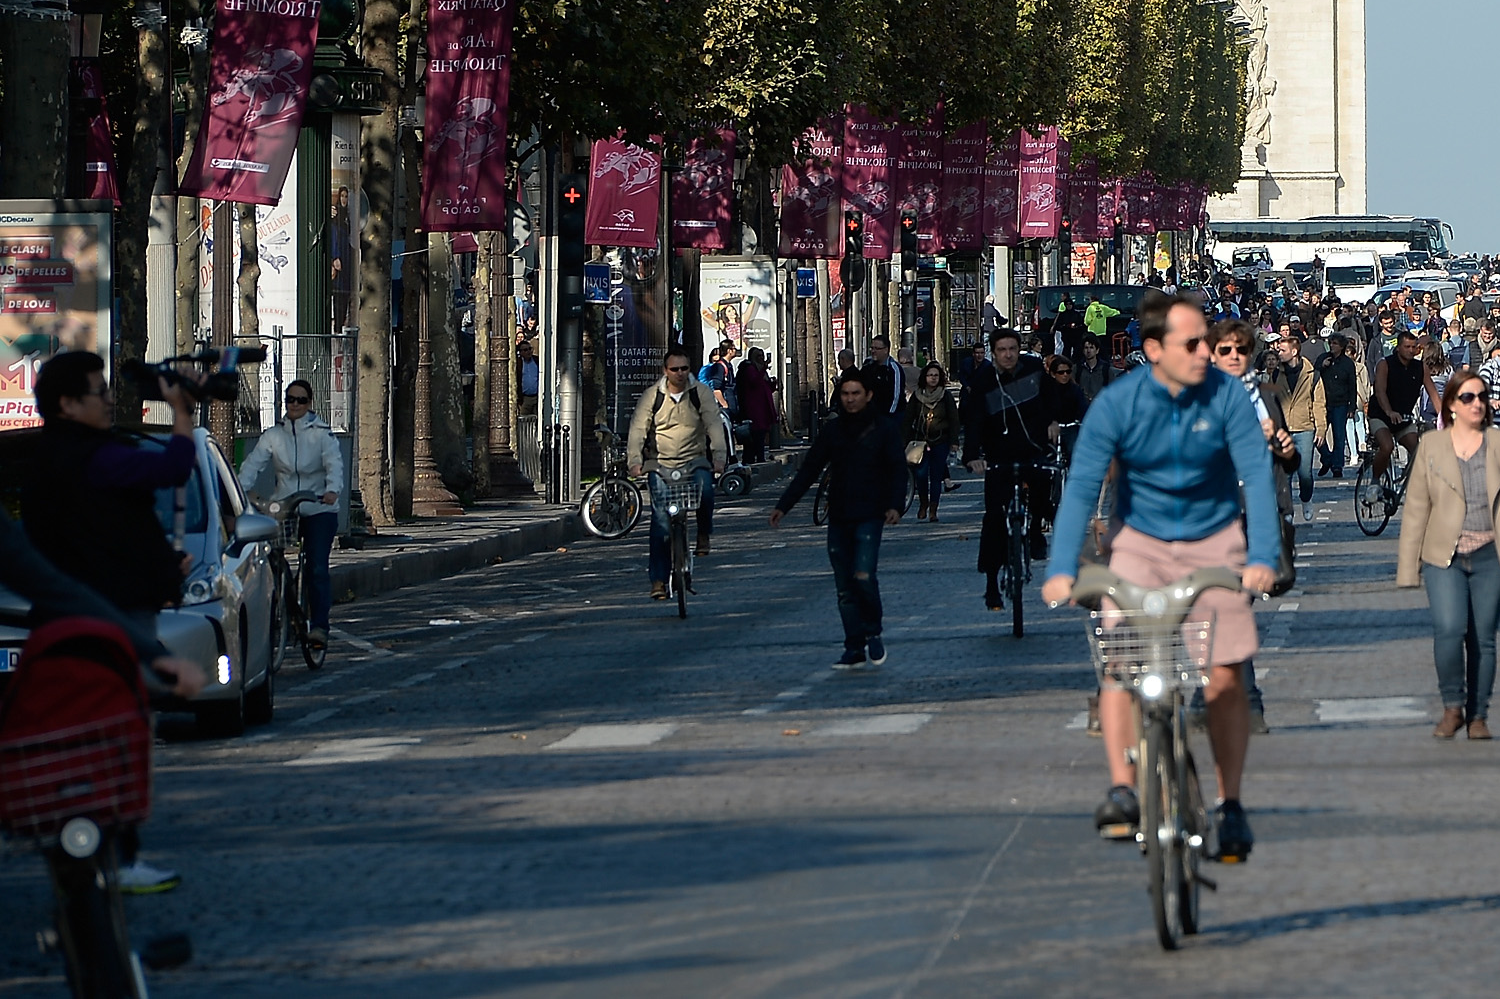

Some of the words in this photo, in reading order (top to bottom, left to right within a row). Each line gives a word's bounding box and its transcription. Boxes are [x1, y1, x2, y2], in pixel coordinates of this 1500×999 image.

[335, 140, 347, 150] Rien
[11, 245, 44, 254] CLASH
[17, 268, 30, 277] DE
[33, 267, 67, 277] PELLES
[8, 300, 21, 308] DE
[23, 299, 51, 308] LOVE
[621, 348, 647, 356] QATAR
[632, 358, 641, 366] DE
[13, 419, 36, 427] C'EST
[9, 651, 20, 667] D
